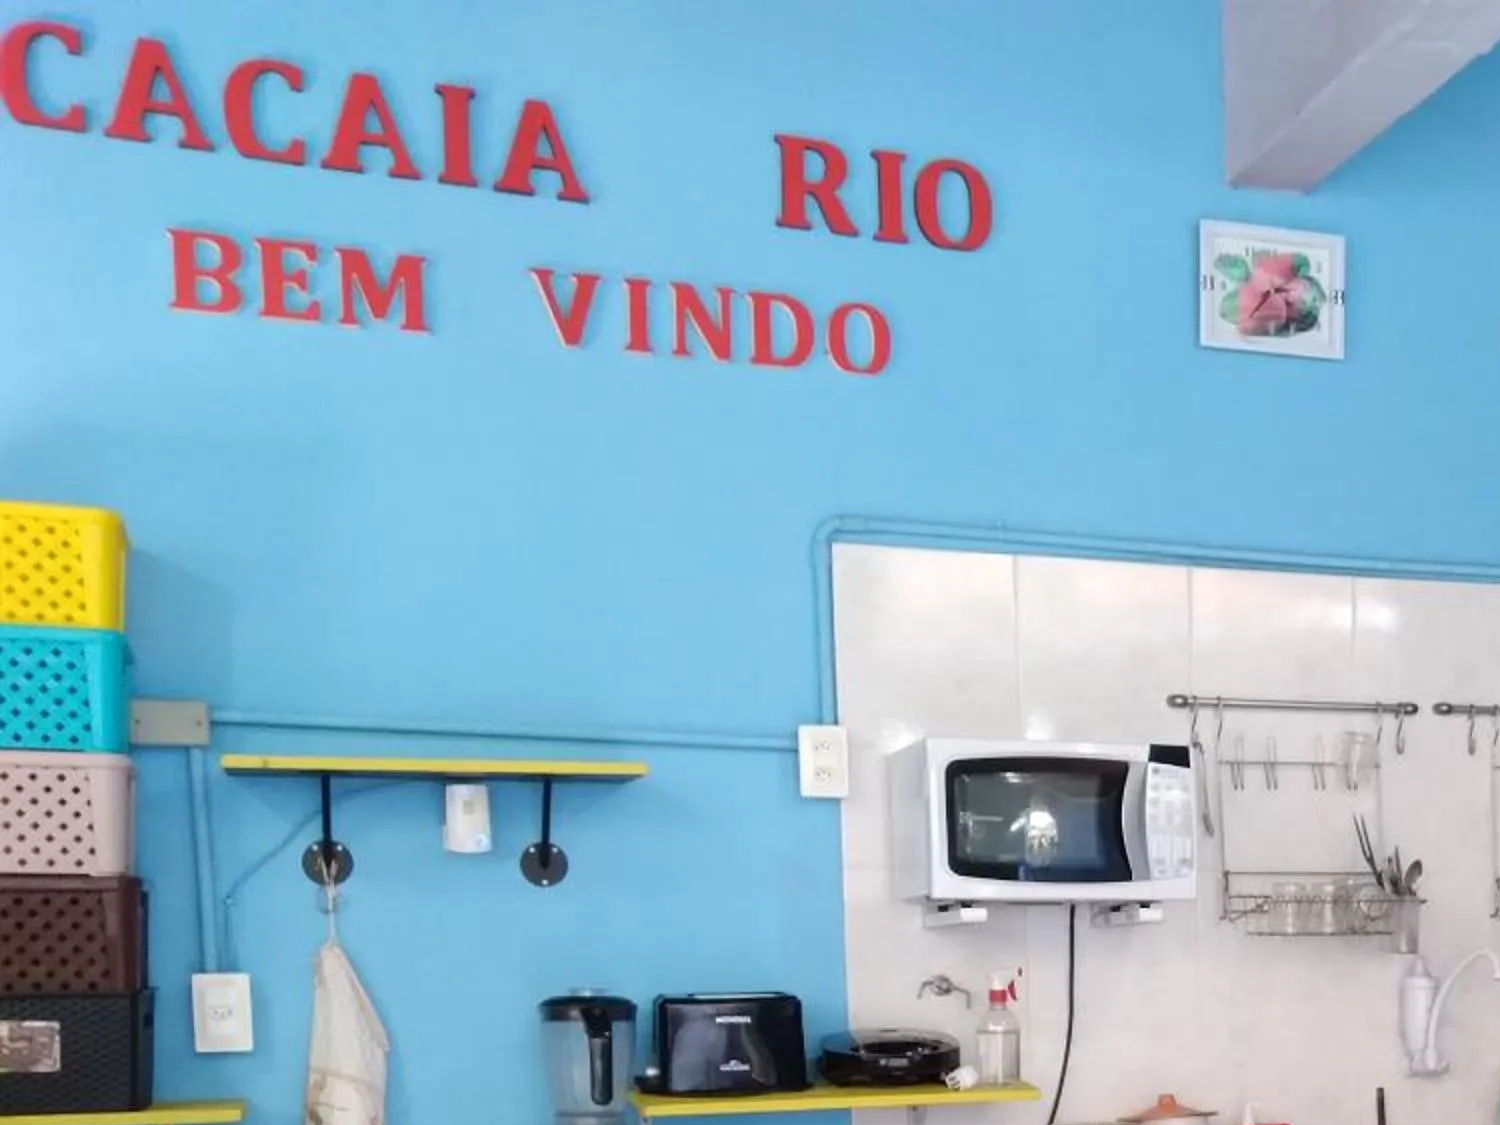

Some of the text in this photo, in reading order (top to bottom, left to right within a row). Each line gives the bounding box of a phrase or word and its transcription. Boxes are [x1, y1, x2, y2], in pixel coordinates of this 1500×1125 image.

[0, 20, 993, 252] CACAIA RIO
[167, 228, 893, 377] BEM VINDO
